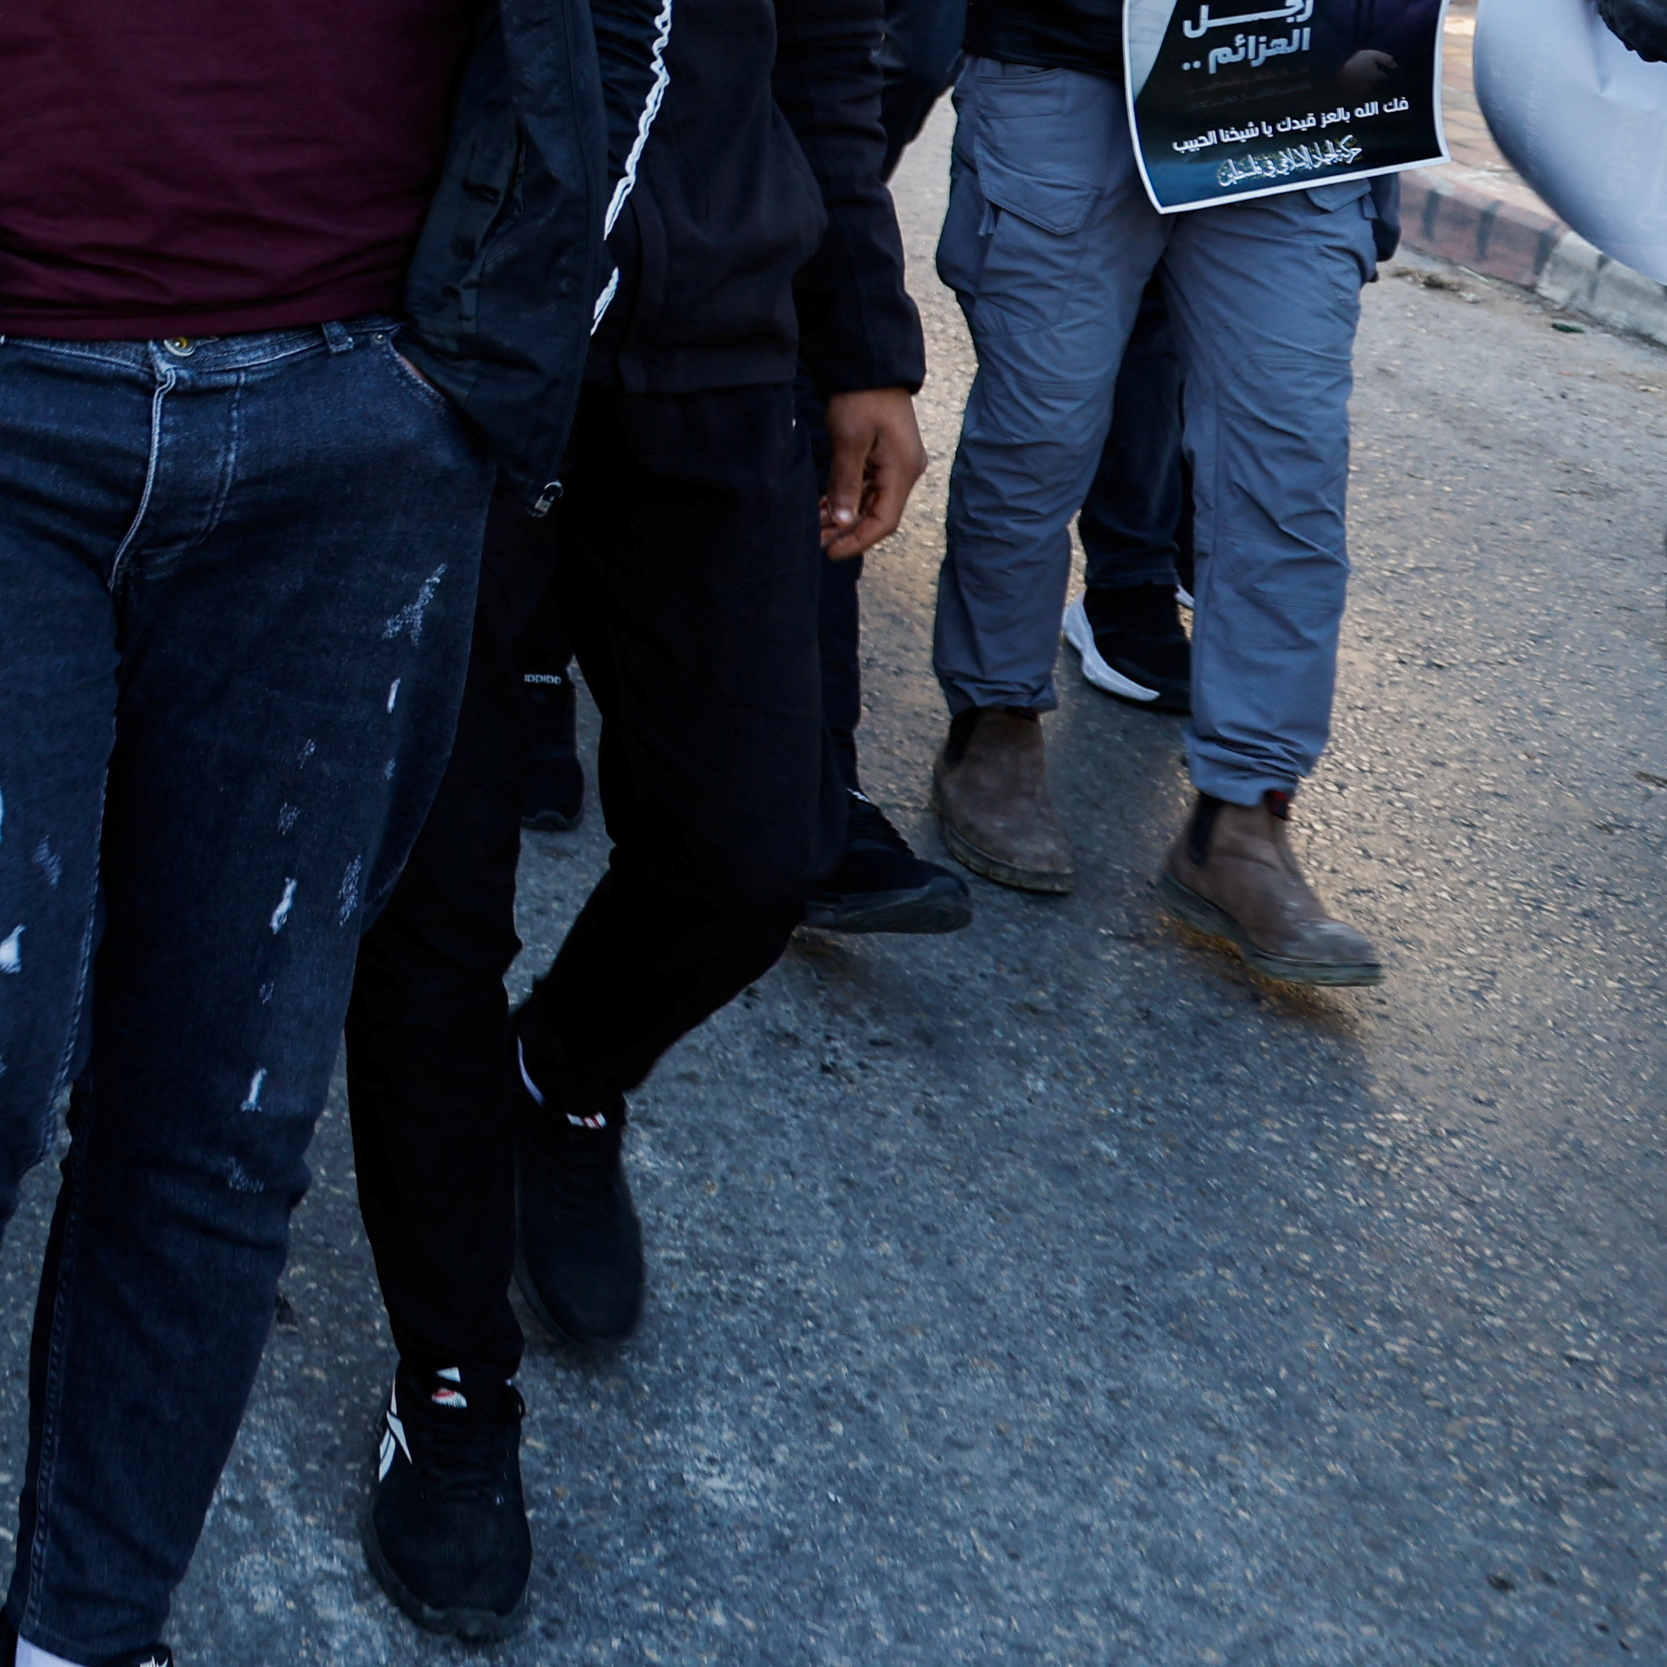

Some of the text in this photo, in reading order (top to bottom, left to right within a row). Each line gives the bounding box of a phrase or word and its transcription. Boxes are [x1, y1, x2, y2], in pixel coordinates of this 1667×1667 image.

[1208, 27, 1311, 74] العزائم
[1354, 101, 1379, 118] الله
[1261, 121, 1273, 138] يا
